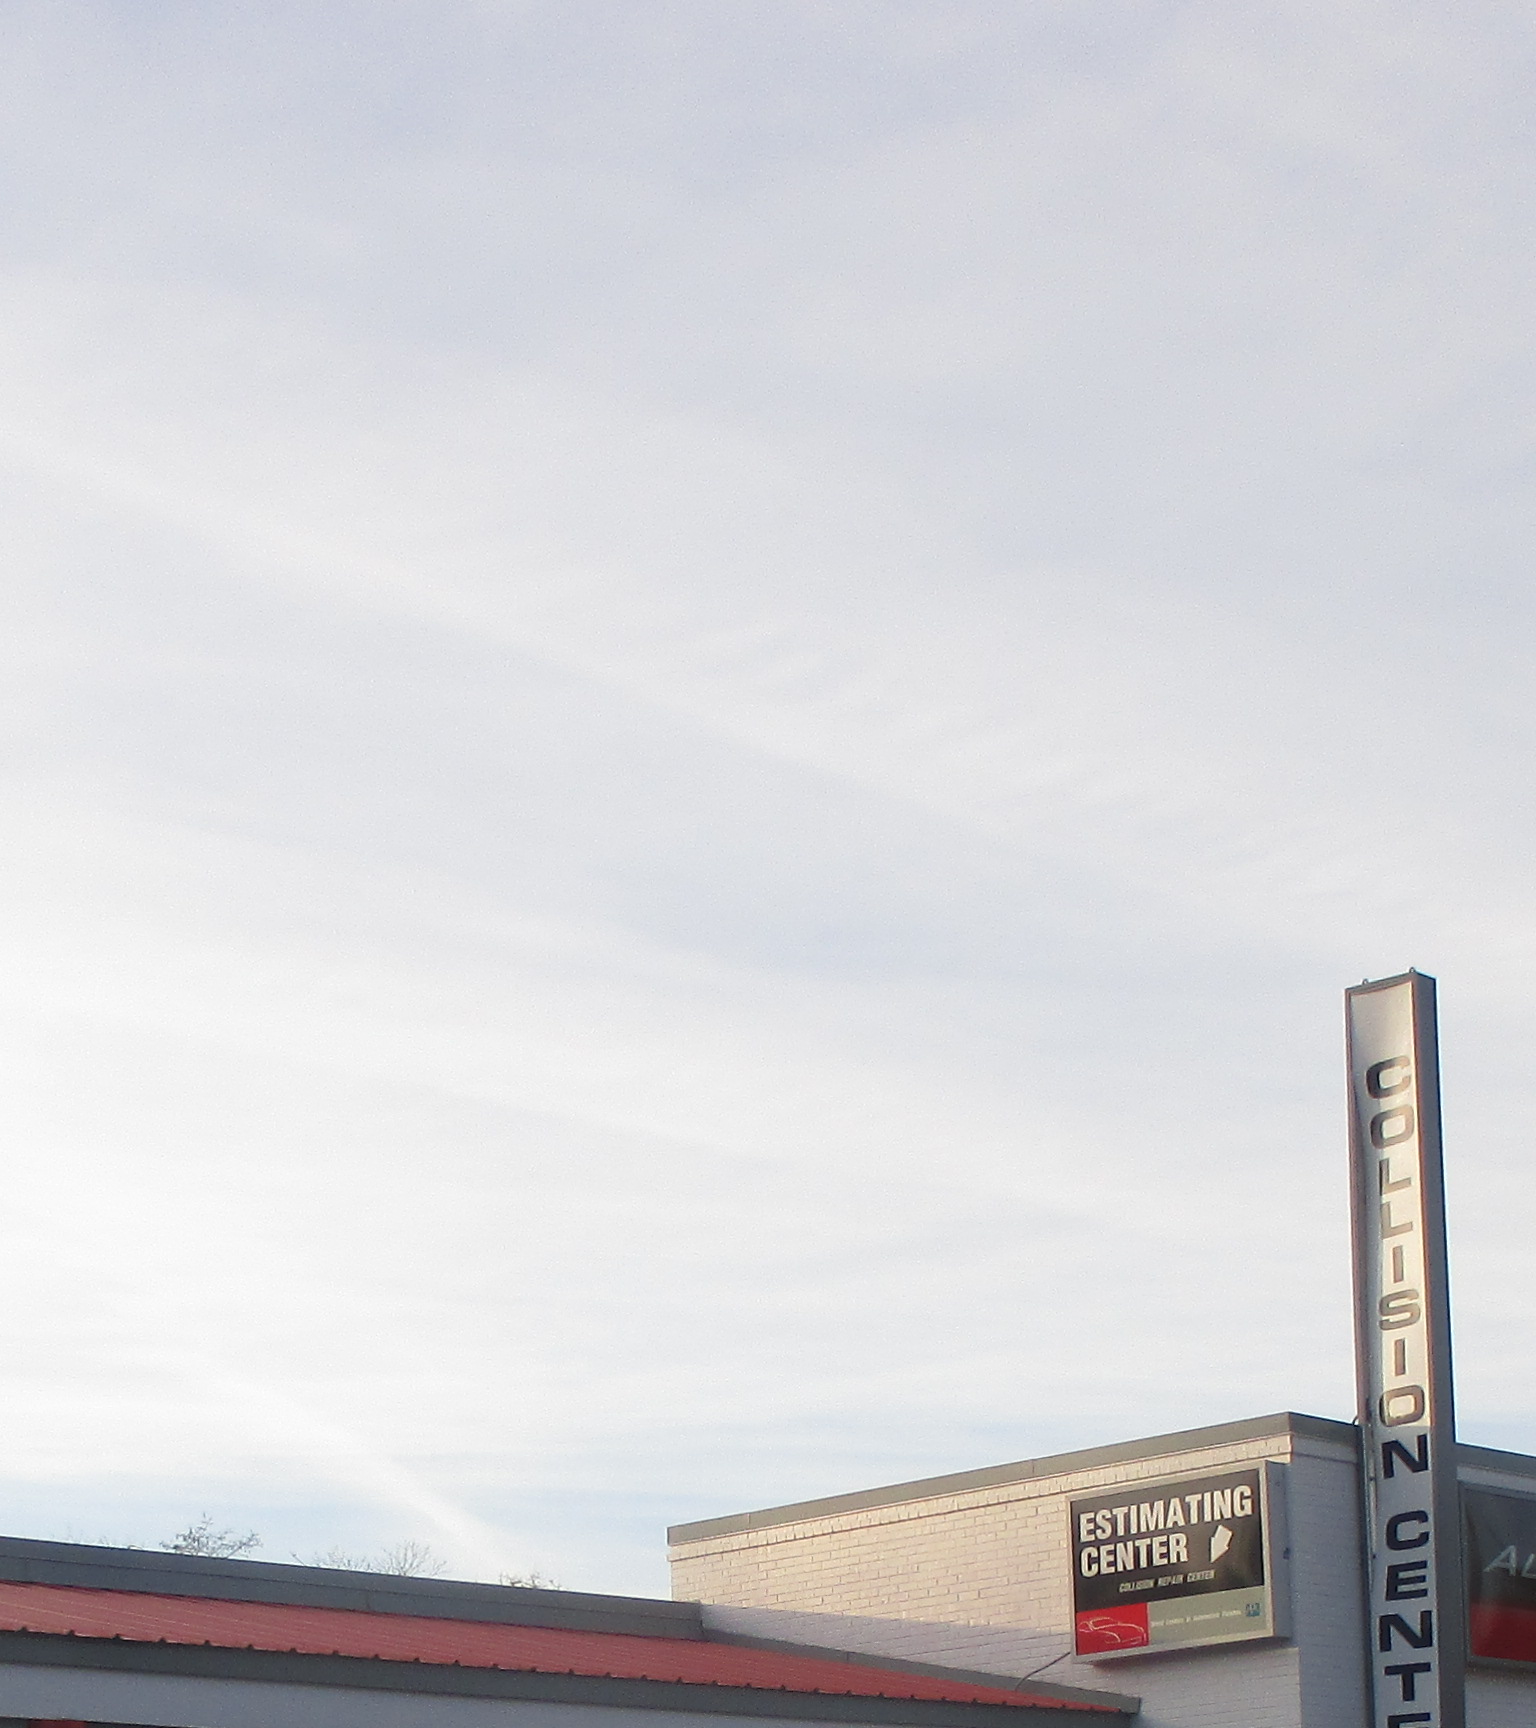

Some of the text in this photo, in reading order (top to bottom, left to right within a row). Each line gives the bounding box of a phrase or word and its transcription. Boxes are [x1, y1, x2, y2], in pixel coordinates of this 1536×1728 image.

[1365, 1054, 1429, 1480] COLLISION
[1079, 1485, 1253, 1543] ESTIMATING
[1080, 1532, 1189, 1578] CENTER
